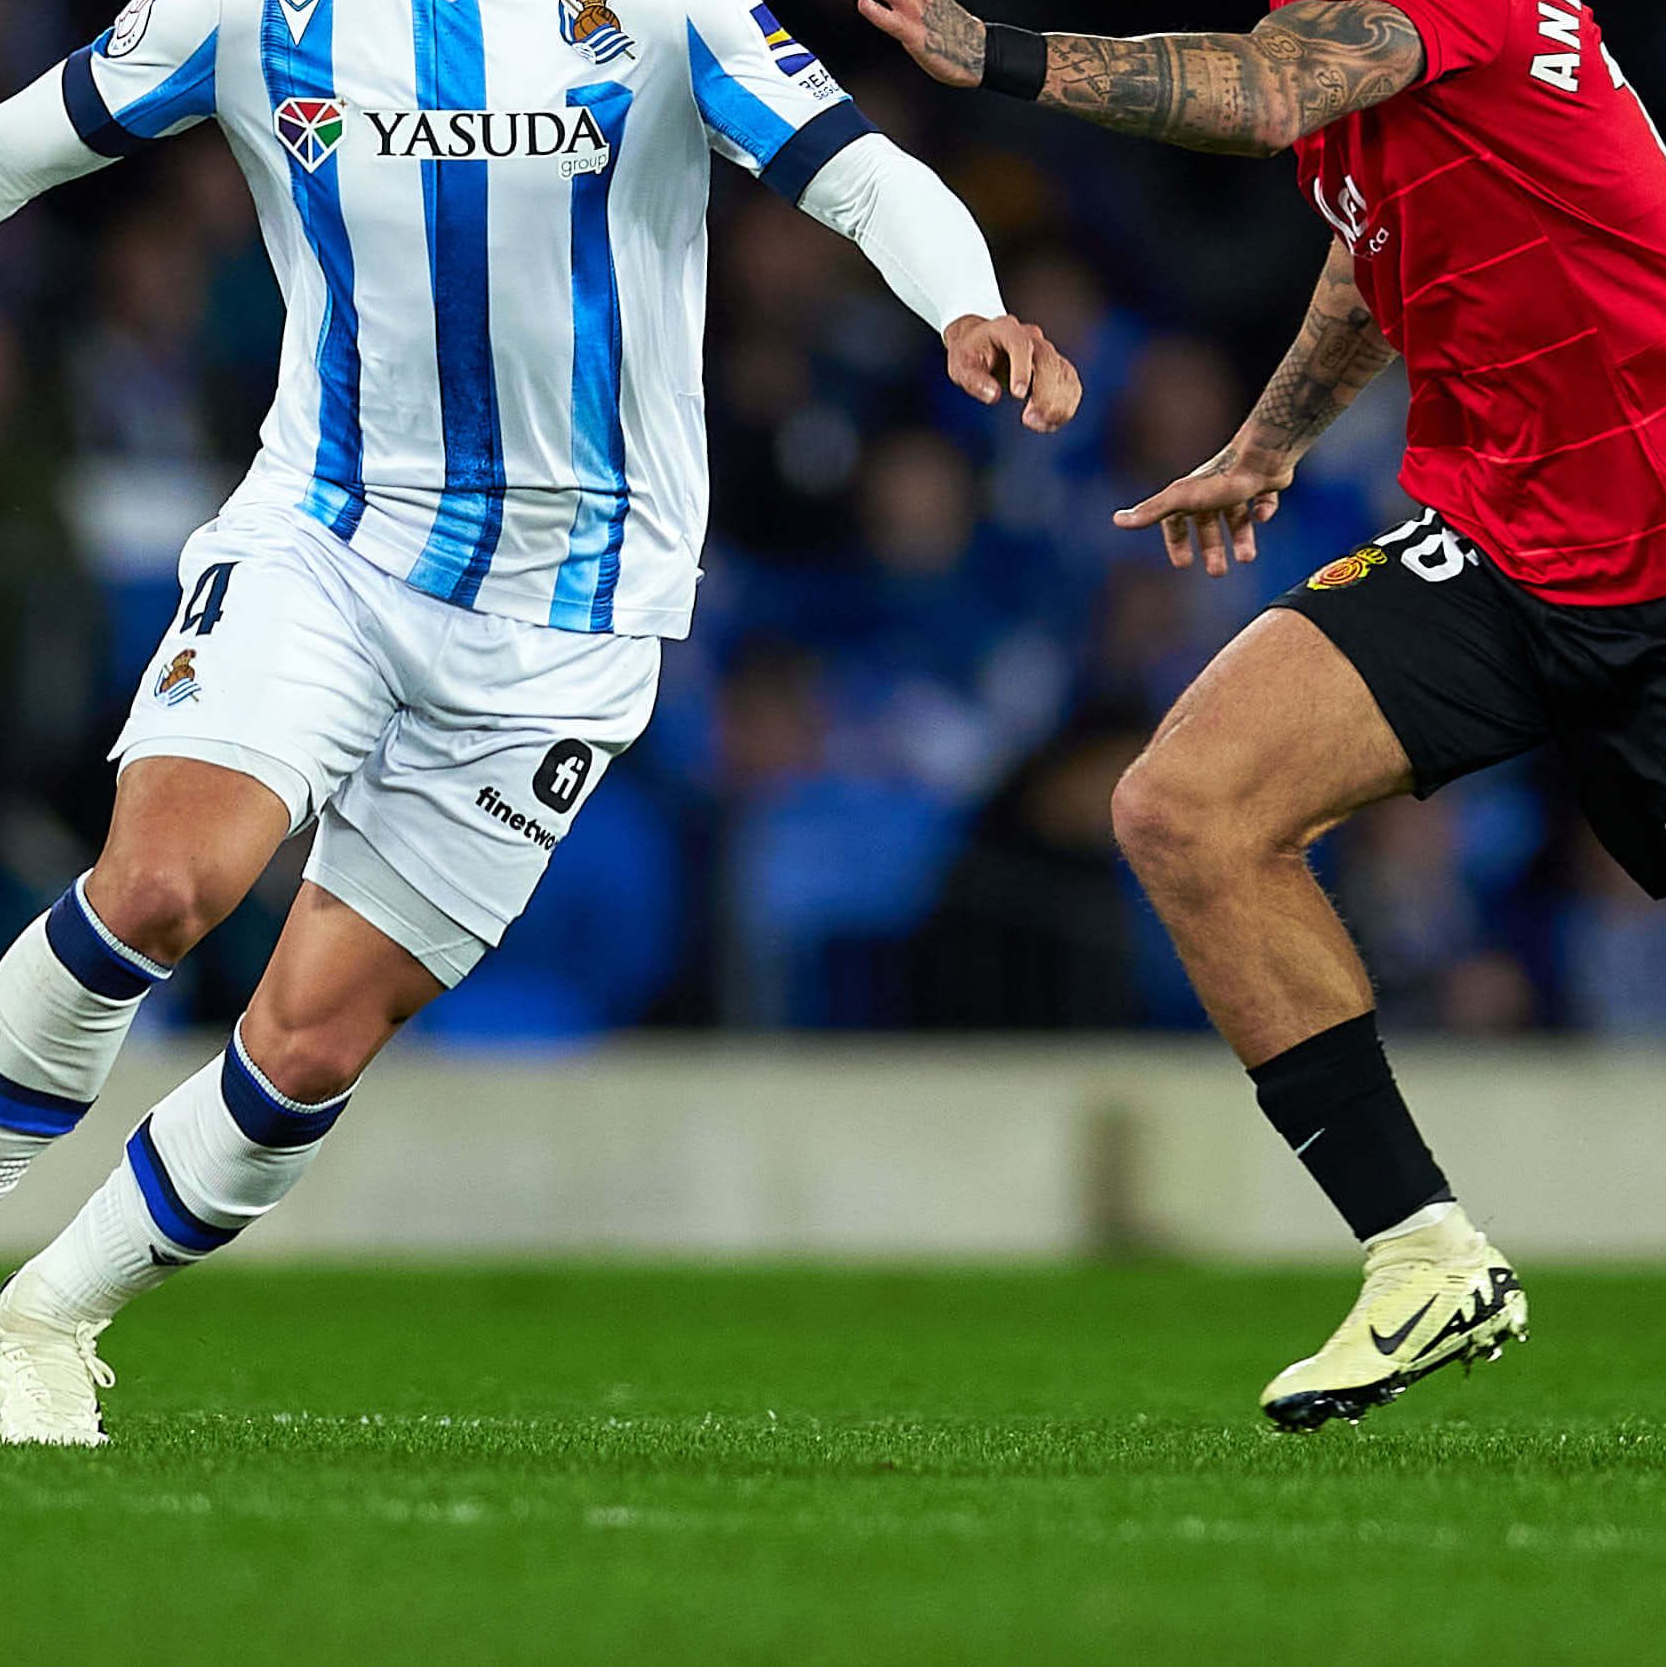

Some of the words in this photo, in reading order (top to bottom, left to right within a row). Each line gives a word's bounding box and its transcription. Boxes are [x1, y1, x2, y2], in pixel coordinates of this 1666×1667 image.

[363, 107, 607, 158] YASUDA
[560, 153, 608, 178] group
[179, 559, 244, 637] 4
[475, 785, 558, 851] finetwo
